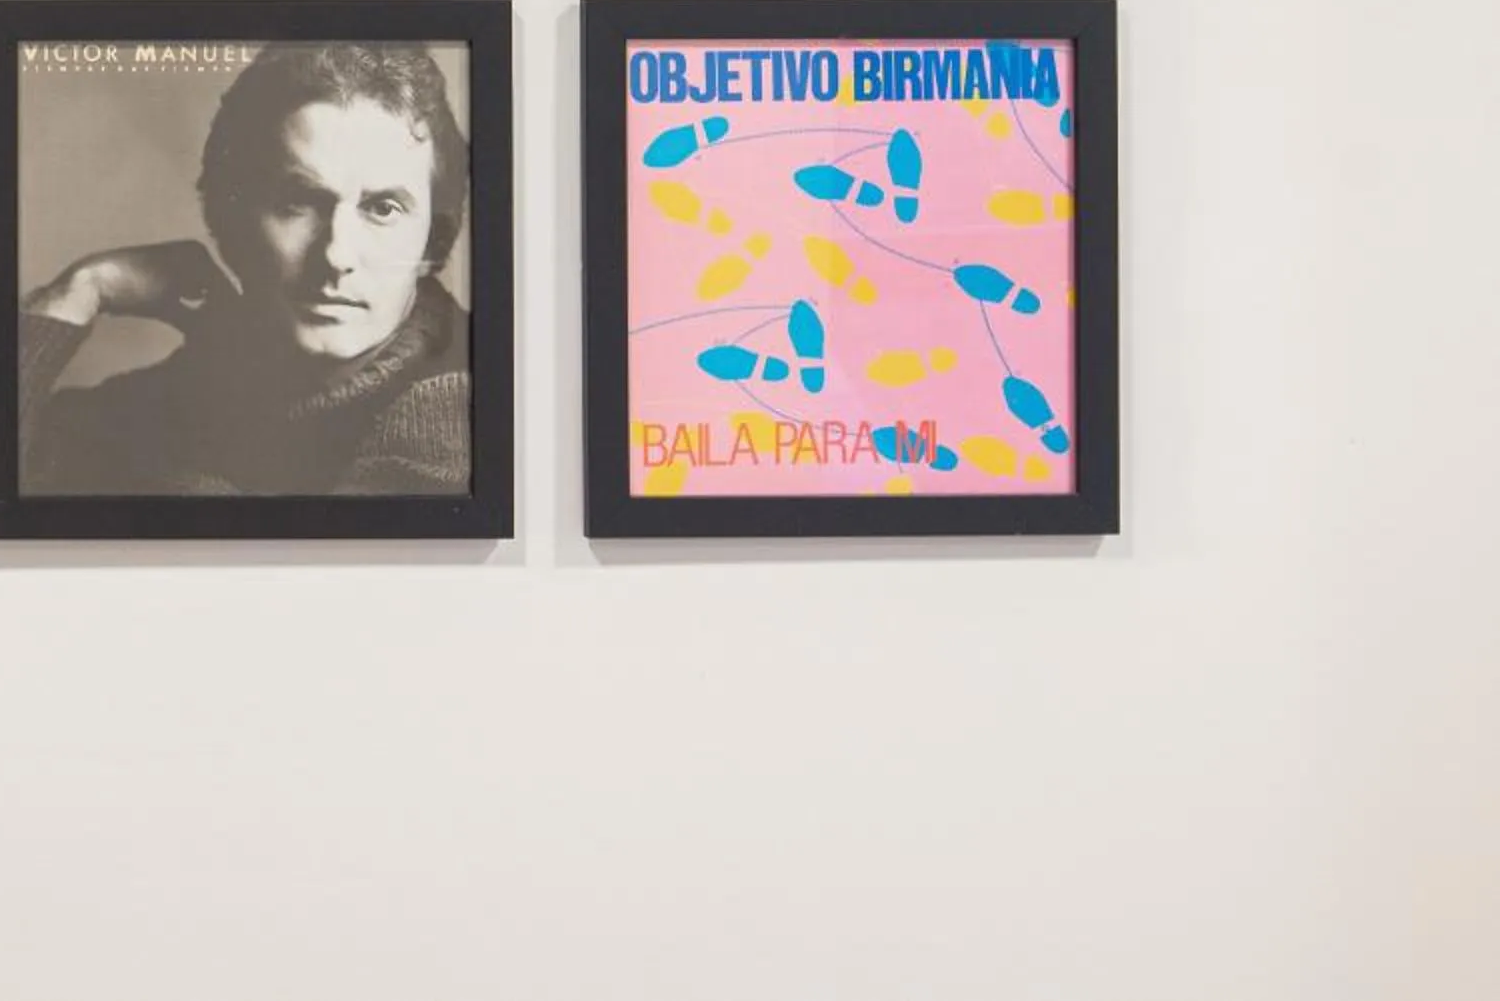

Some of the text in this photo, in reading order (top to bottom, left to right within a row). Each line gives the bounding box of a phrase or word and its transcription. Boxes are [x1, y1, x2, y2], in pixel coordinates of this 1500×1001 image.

[135, 45, 253, 63] MANUEL
[630, 49, 1060, 103] OBJETIVO BIRMANIA
[643, 419, 937, 467] BAILA PARA MI
